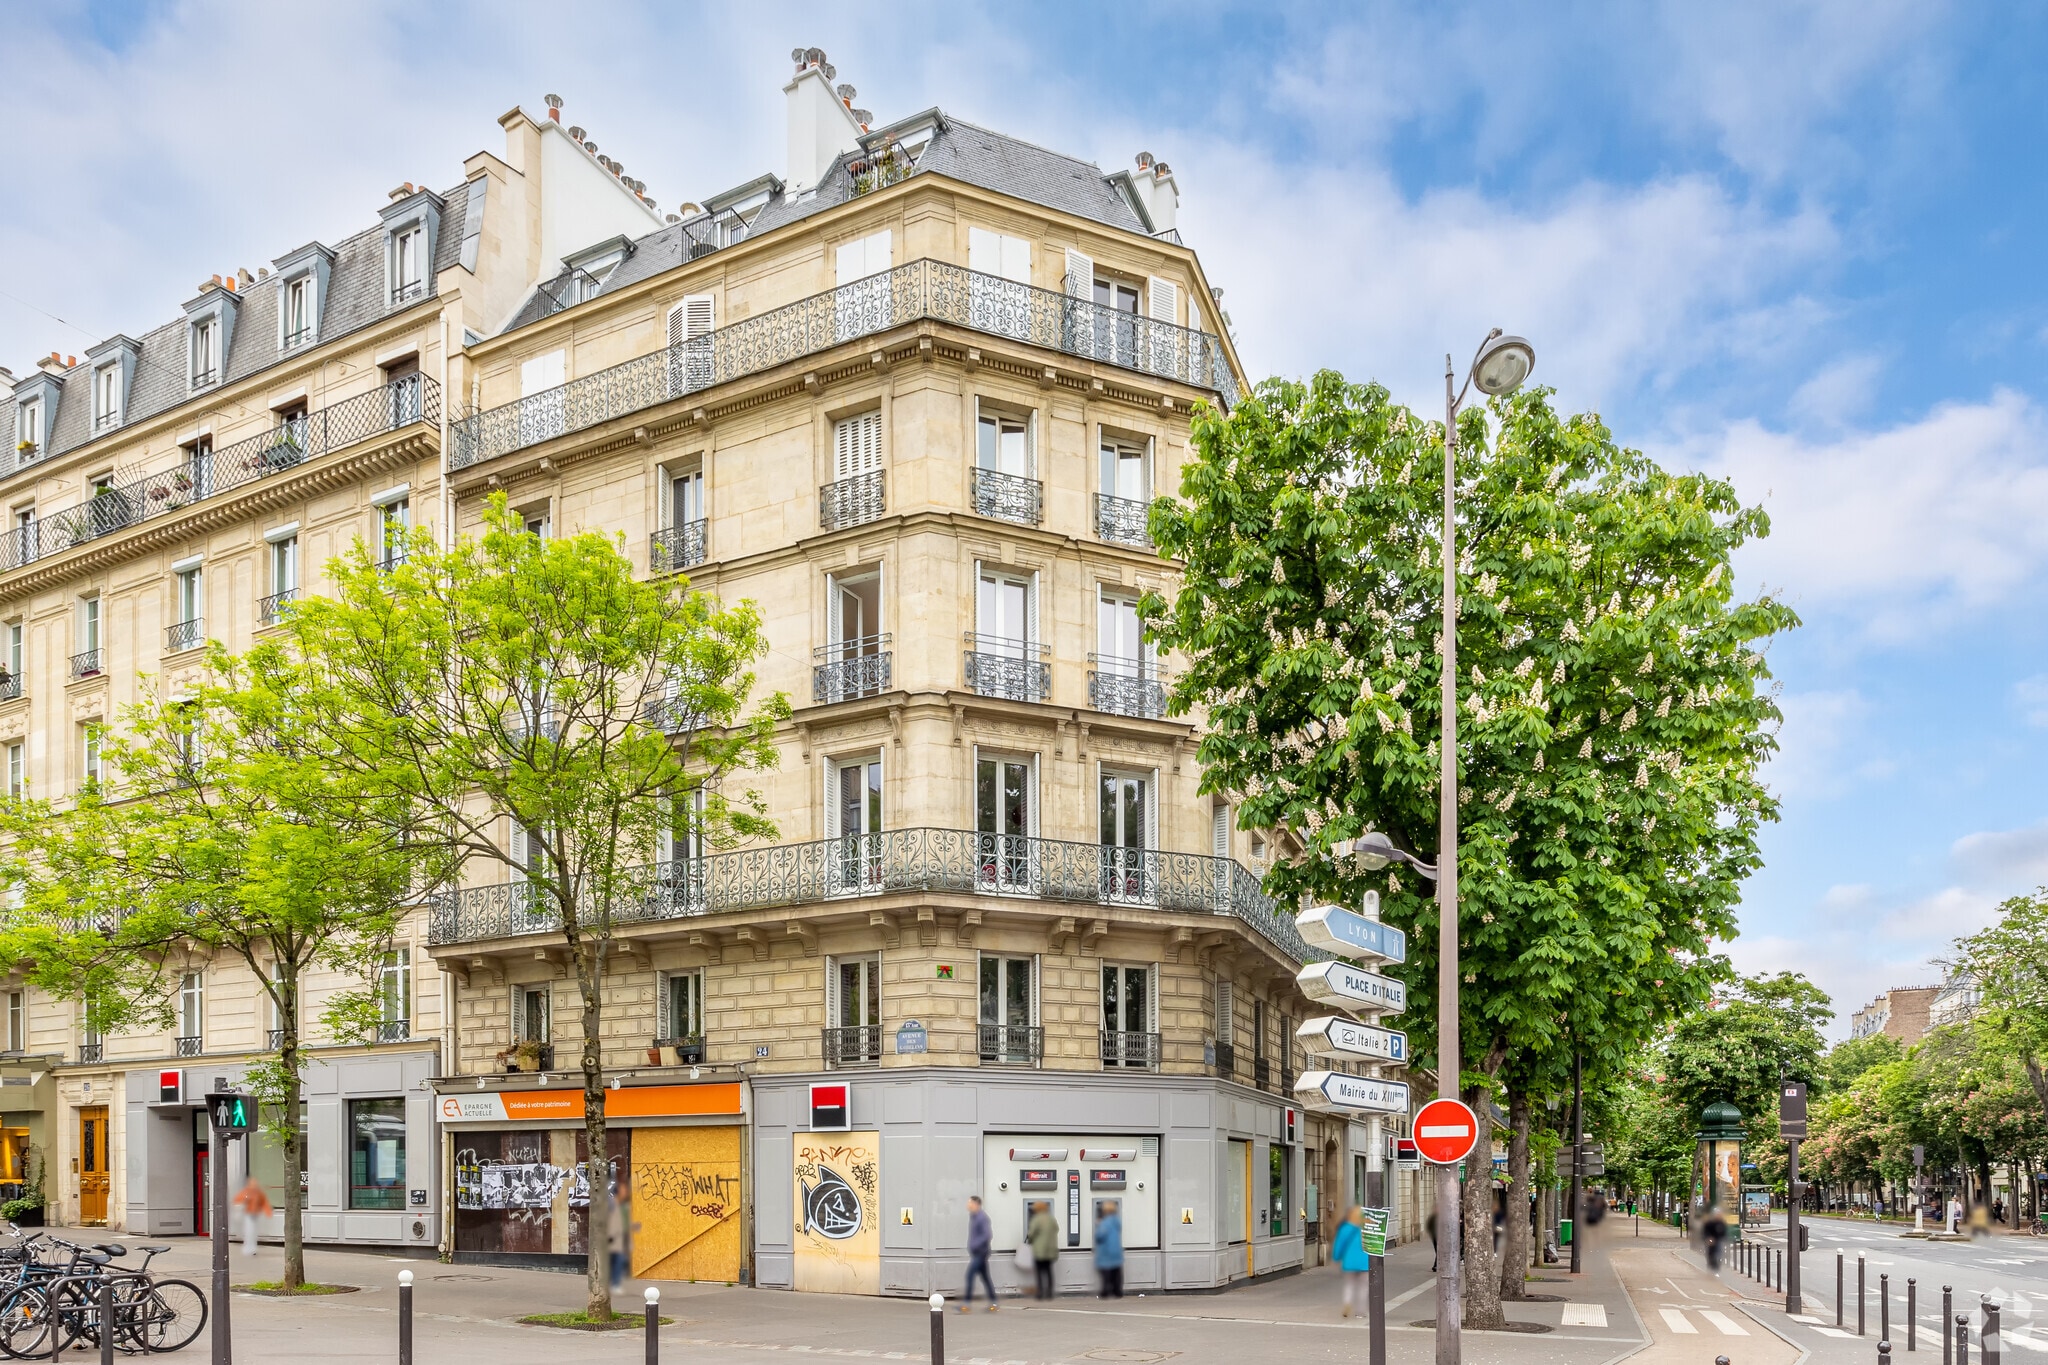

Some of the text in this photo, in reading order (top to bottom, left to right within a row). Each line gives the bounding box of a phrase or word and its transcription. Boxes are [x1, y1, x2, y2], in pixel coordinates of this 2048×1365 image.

[1348, 922, 1376, 943] LYON
[1345, 975, 1401, 1003] PLACE D'ITALIE
[757, 1046, 768, 1056] 24
[1357, 1033, 1400, 1054] Italie 2 P
[1339, 1083, 1366, 1099] Mairie
[1368, 1088, 1378, 1101] du
[509, 1101, 528, 1109] Dédiée
[544, 1101, 571, 1109] patrimoine
[1100, 1171, 1118, 1179] Retrait
[691, 1173, 739, 1206] WHAT
